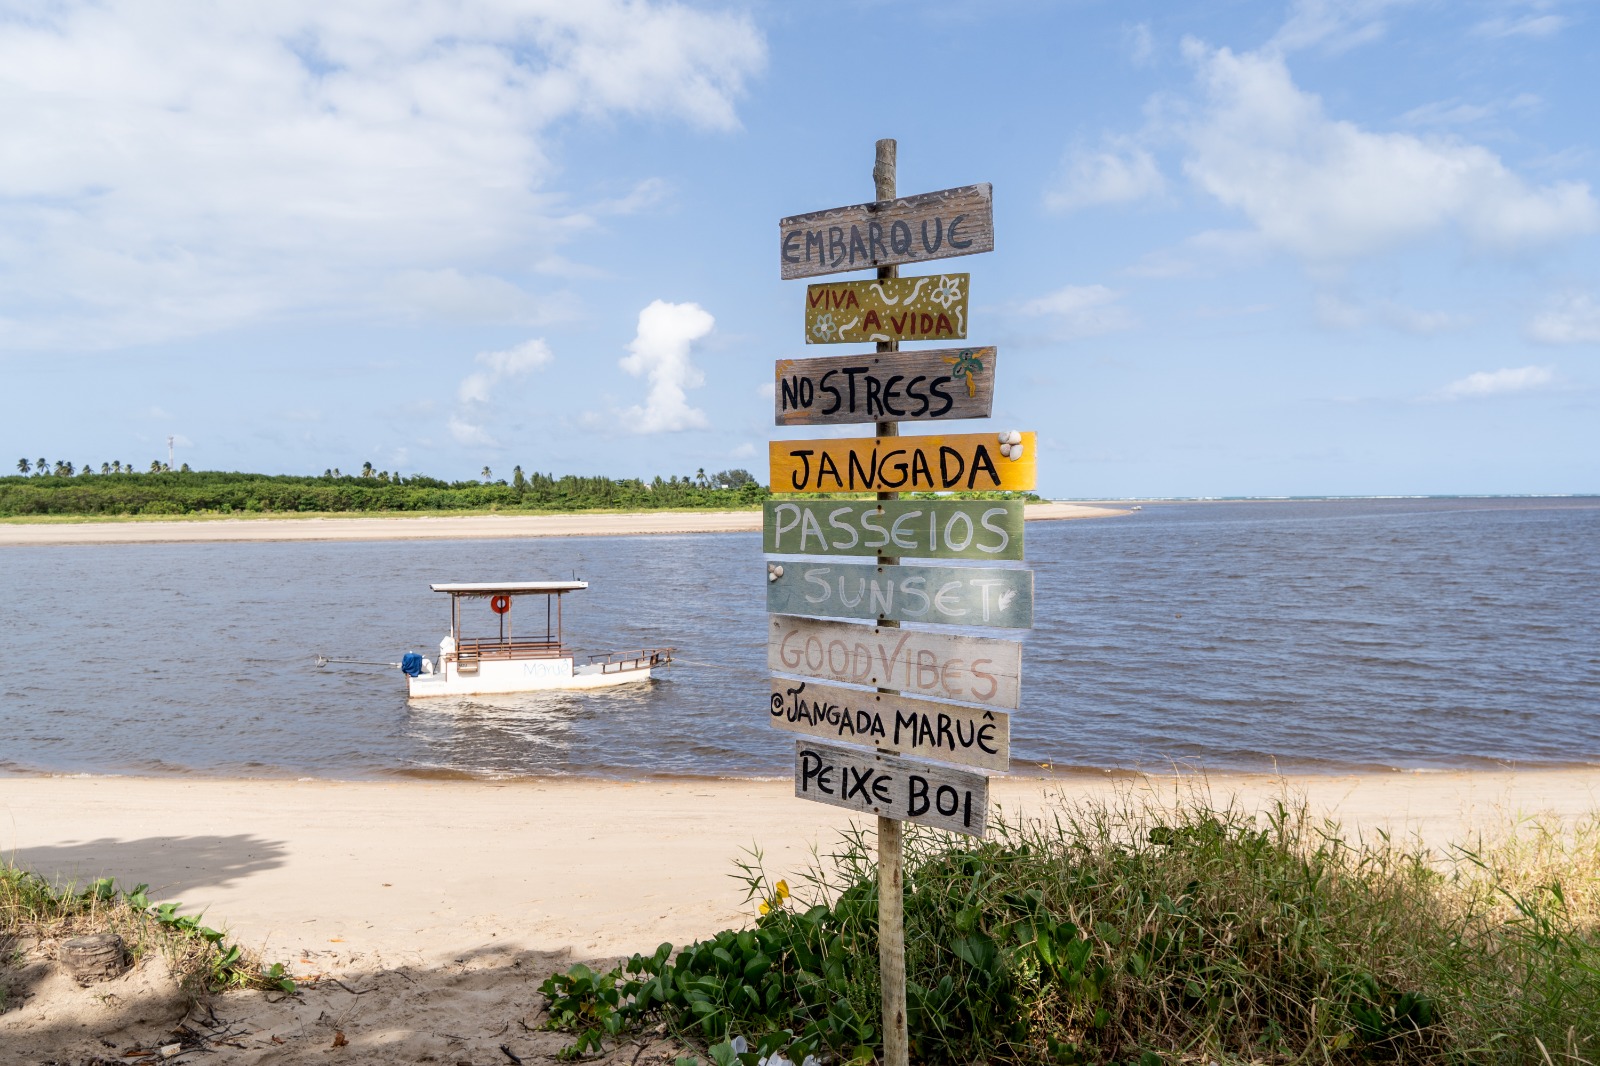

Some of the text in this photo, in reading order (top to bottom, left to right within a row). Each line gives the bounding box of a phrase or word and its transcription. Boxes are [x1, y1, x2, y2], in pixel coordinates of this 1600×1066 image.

[782, 213, 973, 267] EMBARQUE
[808, 289, 860, 310] VIVA
[862, 310, 953, 335] A VIDA
[781, 366, 955, 417] NO STRESS
[790, 444, 1001, 490] JANGADA
[774, 503, 1009, 553] PASSEIOS
[804, 567, 1005, 622] SUNSET
[893, 711, 999, 754] MARUÊ
[800, 751, 972, 828] PEIXE BOI
